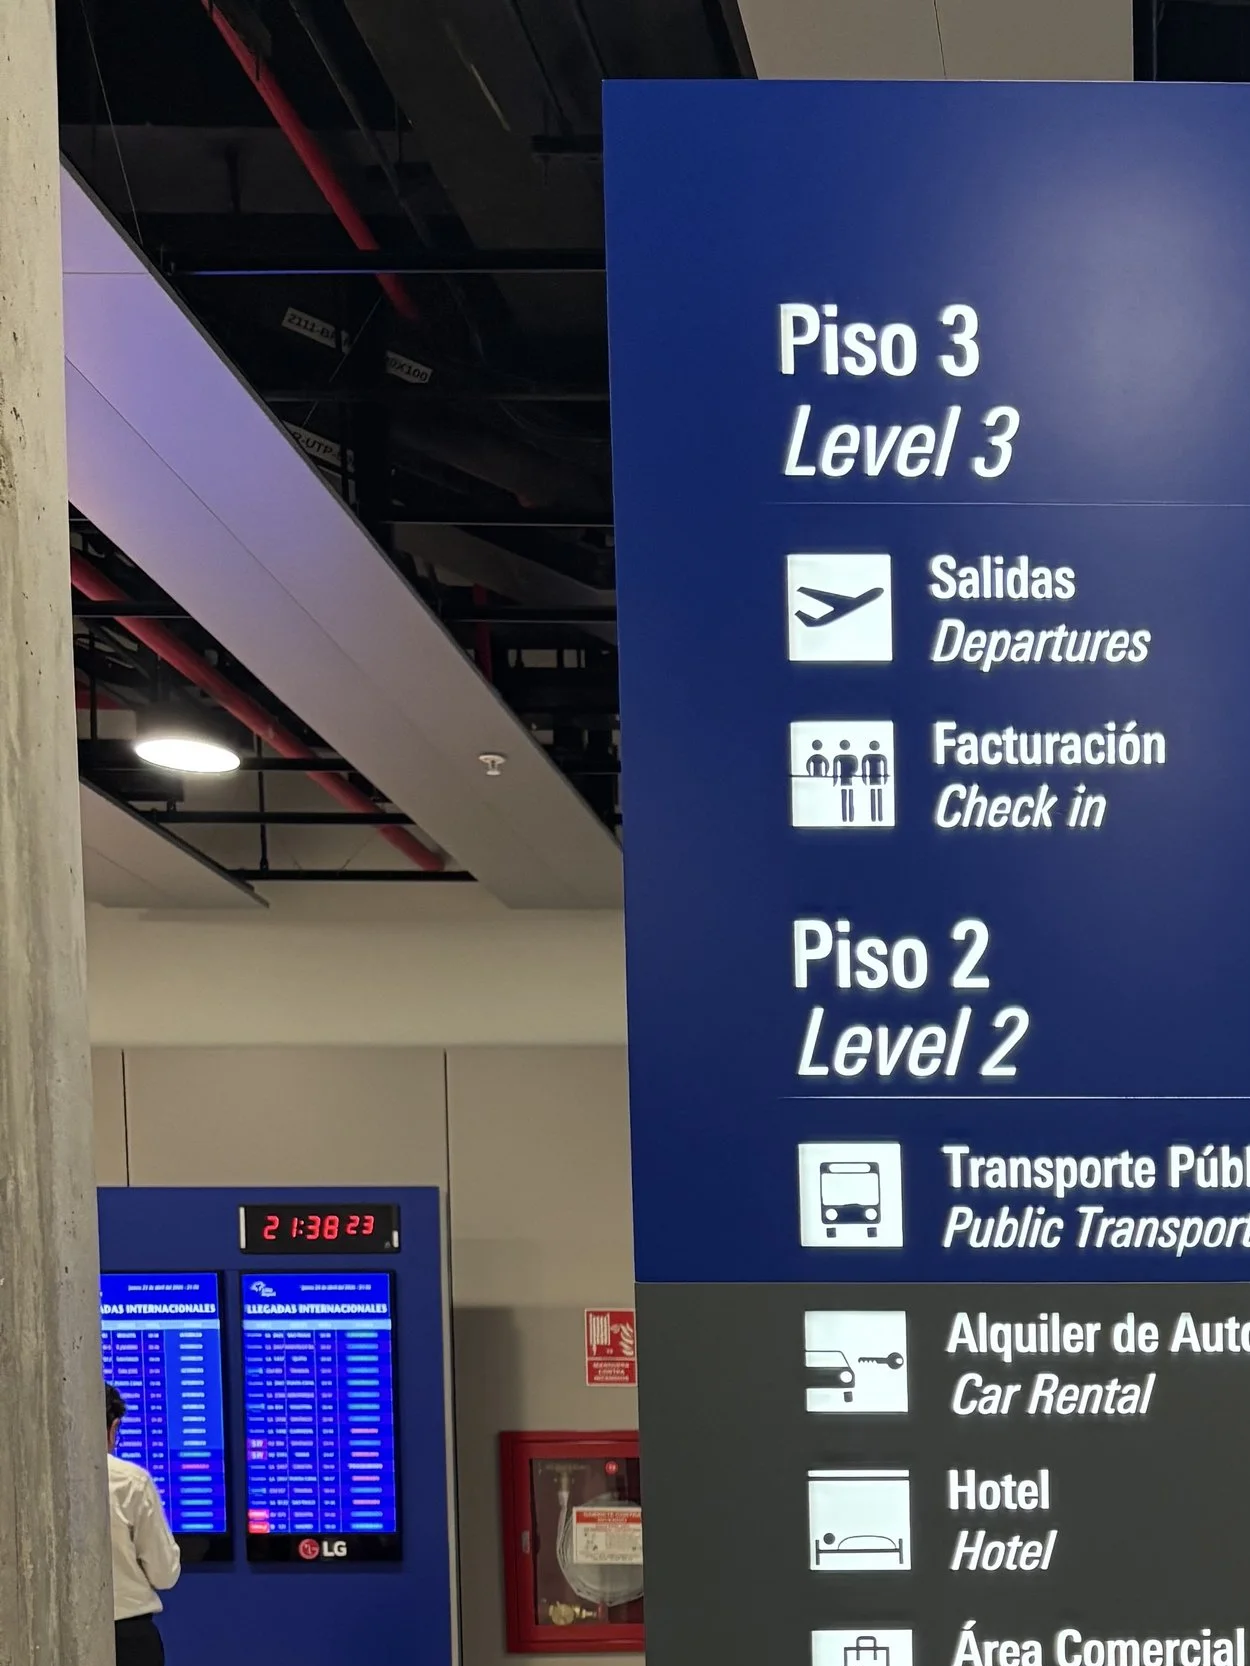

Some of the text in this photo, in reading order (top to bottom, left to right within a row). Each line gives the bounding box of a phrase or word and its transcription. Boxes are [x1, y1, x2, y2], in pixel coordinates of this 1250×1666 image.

[780, 303, 979, 376] Piso 3
[785, 405, 1019, 477] Level 3
[930, 555, 1075, 599] Salidas
[931, 619, 1151, 672] Departures
[934, 721, 1165, 764] Facturación
[935, 784, 1106, 828] Check in
[794, 920, 989, 988] Piso 2
[798, 1007, 1029, 1076] Level 2
[942, 1146, 1155, 1197] Transporte
[262, 1215, 375, 1241] 21:38 23
[944, 1207, 1063, 1247] Public
[126, 1303, 216, 1314] INTERNACIONALES
[246, 1303, 388, 1315] LLEGADAS INTERNACIONALES
[946, 1313, 1101, 1362] Alquiler
[1113, 1313, 1158, 1352] de
[953, 1373, 1156, 1415] Car Rental
[949, 1469, 1049, 1509] Hotel
[322, 1540, 347, 1557] LG
[951, 1530, 1057, 1570] Hotel
